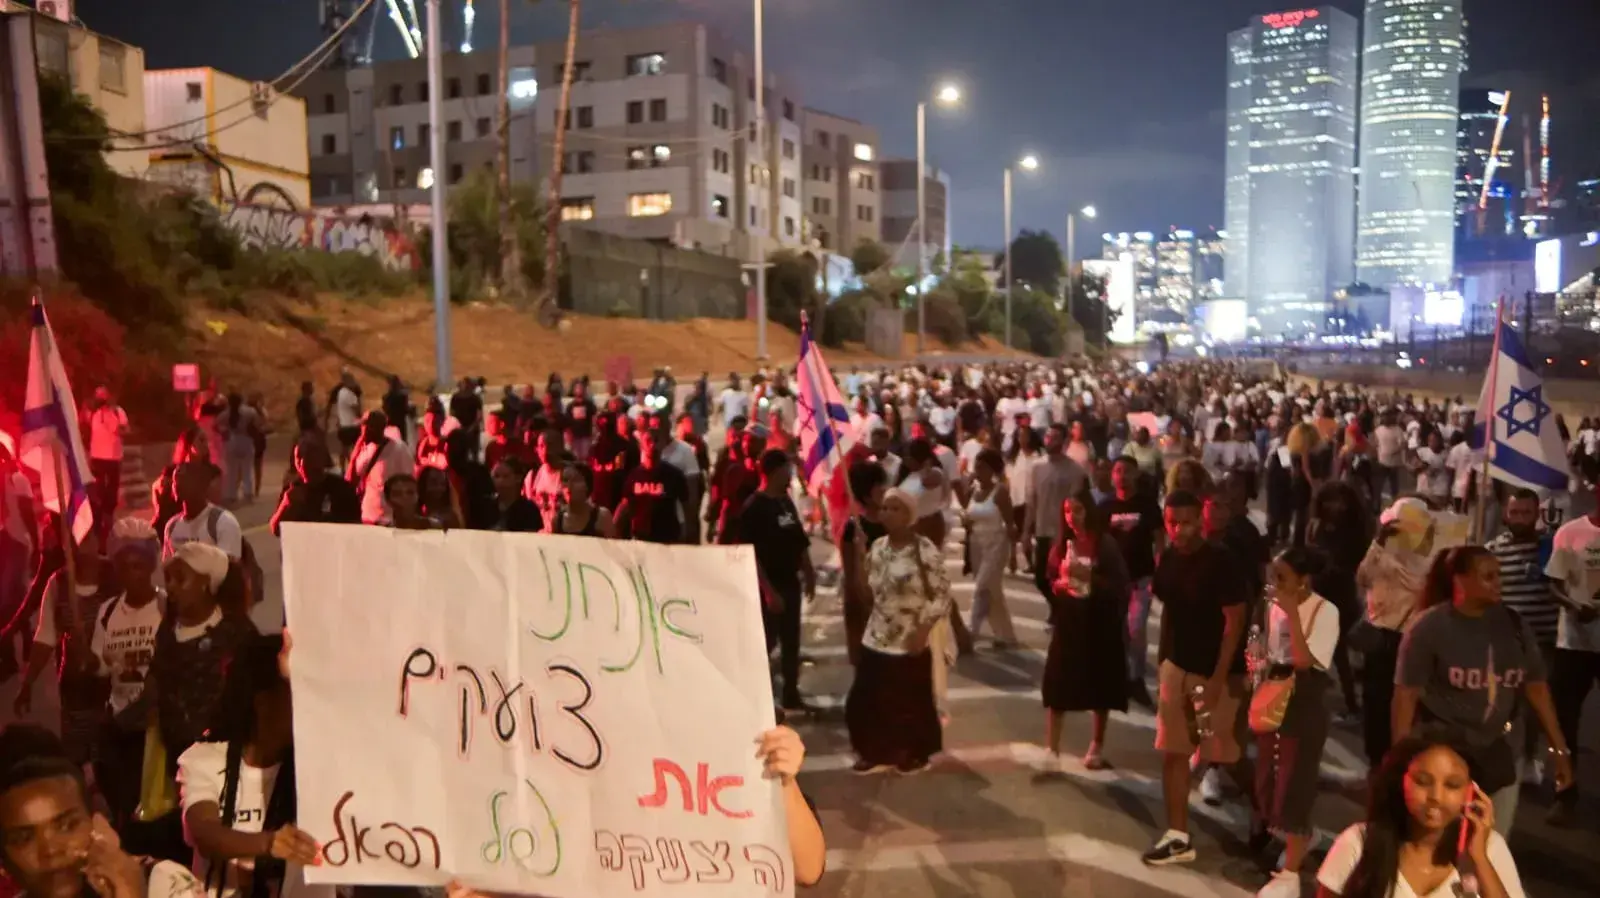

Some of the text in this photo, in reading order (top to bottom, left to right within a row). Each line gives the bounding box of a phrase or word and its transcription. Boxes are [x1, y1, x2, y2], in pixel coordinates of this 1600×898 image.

[531, 547, 702, 675] אנחנו
[399, 647, 604, 771] צועקים
[323, 791, 440, 869] רפאל
[483, 779, 560, 876] של
[638, 758, 754, 818] את
